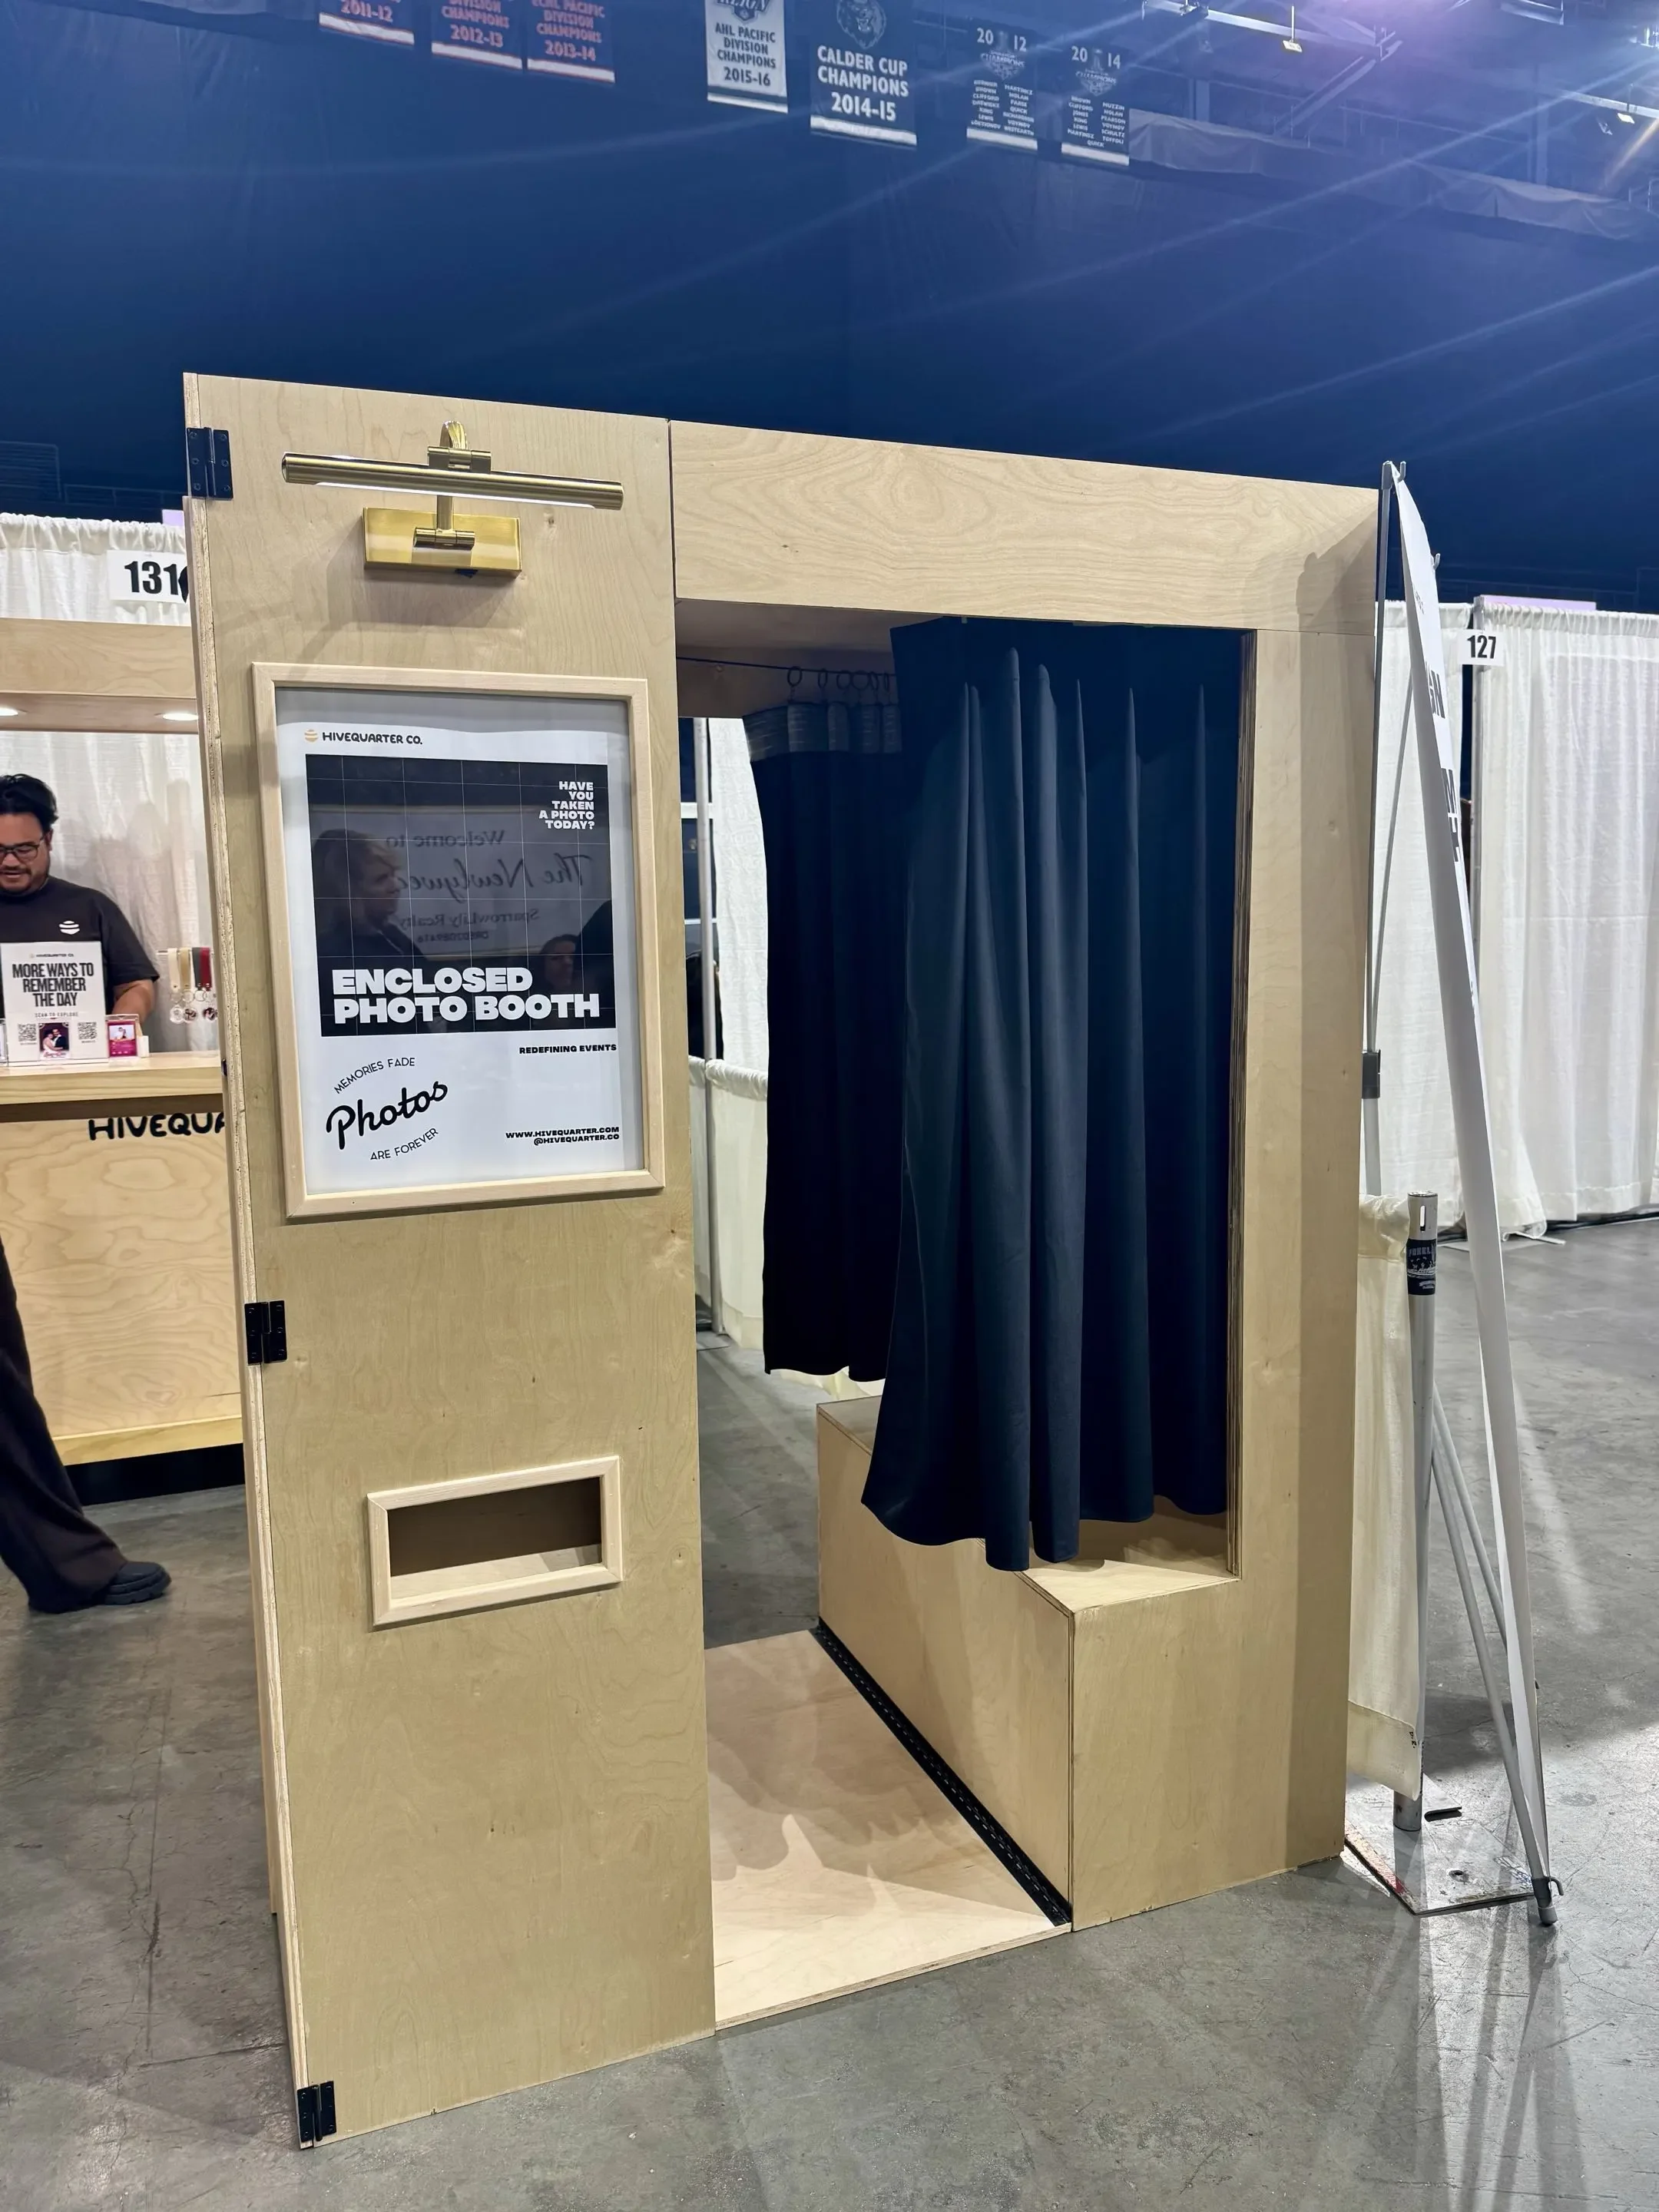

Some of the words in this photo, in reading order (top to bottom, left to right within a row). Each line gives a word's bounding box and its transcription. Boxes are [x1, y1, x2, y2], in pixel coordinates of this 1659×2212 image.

[341, 0, 393, 22] 2011-12
[442, 6, 509, 28] CHAMPIONS
[564, 0, 606, 18] PACIFIC
[544, 10, 594, 29] DIVISION
[450, 25, 503, 48] 2012-13
[536, 23, 602, 43] CHAMPIONS
[715, 22, 735, 36] AHL
[738, 25, 776, 43] PACIFIC
[976, 28, 994, 45] 20
[1014, 35, 1027, 52] 12
[545, 40, 596, 61] 2013-14
[724, 37, 768, 55] DIVISION
[717, 49, 777, 69] CHAMPIONS
[817, 45, 874, 71] CALDER
[879, 57, 908, 77] CUP
[1071, 46, 1088, 63] 20
[1108, 52, 1121, 70] 14
[724, 67, 771, 87] 2015-16
[817, 65, 909, 98] CHAMPIONS
[831, 91, 896, 121] 2014-15
[1466, 634, 1497, 659] 127
[322, 730, 404, 745] HIVEQUARTER
[406, 734, 423, 745] CO.
[558, 780, 594, 791] HAVE
[568, 790, 594, 801] YOU
[538, 810, 548, 820] A
[551, 810, 595, 820] PHOTO
[551, 800, 594, 810] TAKEN
[545, 820, 595, 830] TODAY?
[12, 963, 45, 978] MORE
[46, 962, 78, 977] WAYS
[79, 962, 94, 977] TO
[22, 977, 86, 992] REMEMBER
[332, 967, 533, 995] ENCLOSED
[32, 993, 55, 1007] THE
[57, 992, 78, 1007] DAY
[333, 995, 468, 1024] PHOTO
[475, 993, 600, 1021] BOOTH
[518, 1045, 578, 1055] REDEFINING
[578, 1043, 618, 1053] EVENTS
[333, 1061, 384, 1094] MEMORIES
[387, 1056, 416, 1068] FADE
[326, 1081, 449, 1151] Photos
[505, 1126, 620, 1139] WWW.HIVEQUARTER.COM
[533, 1133, 620, 1146] @HIVEQUARTER.CO
[370, 1149, 392, 1161] ARE
[394, 1128, 439, 1157] FOREVER
